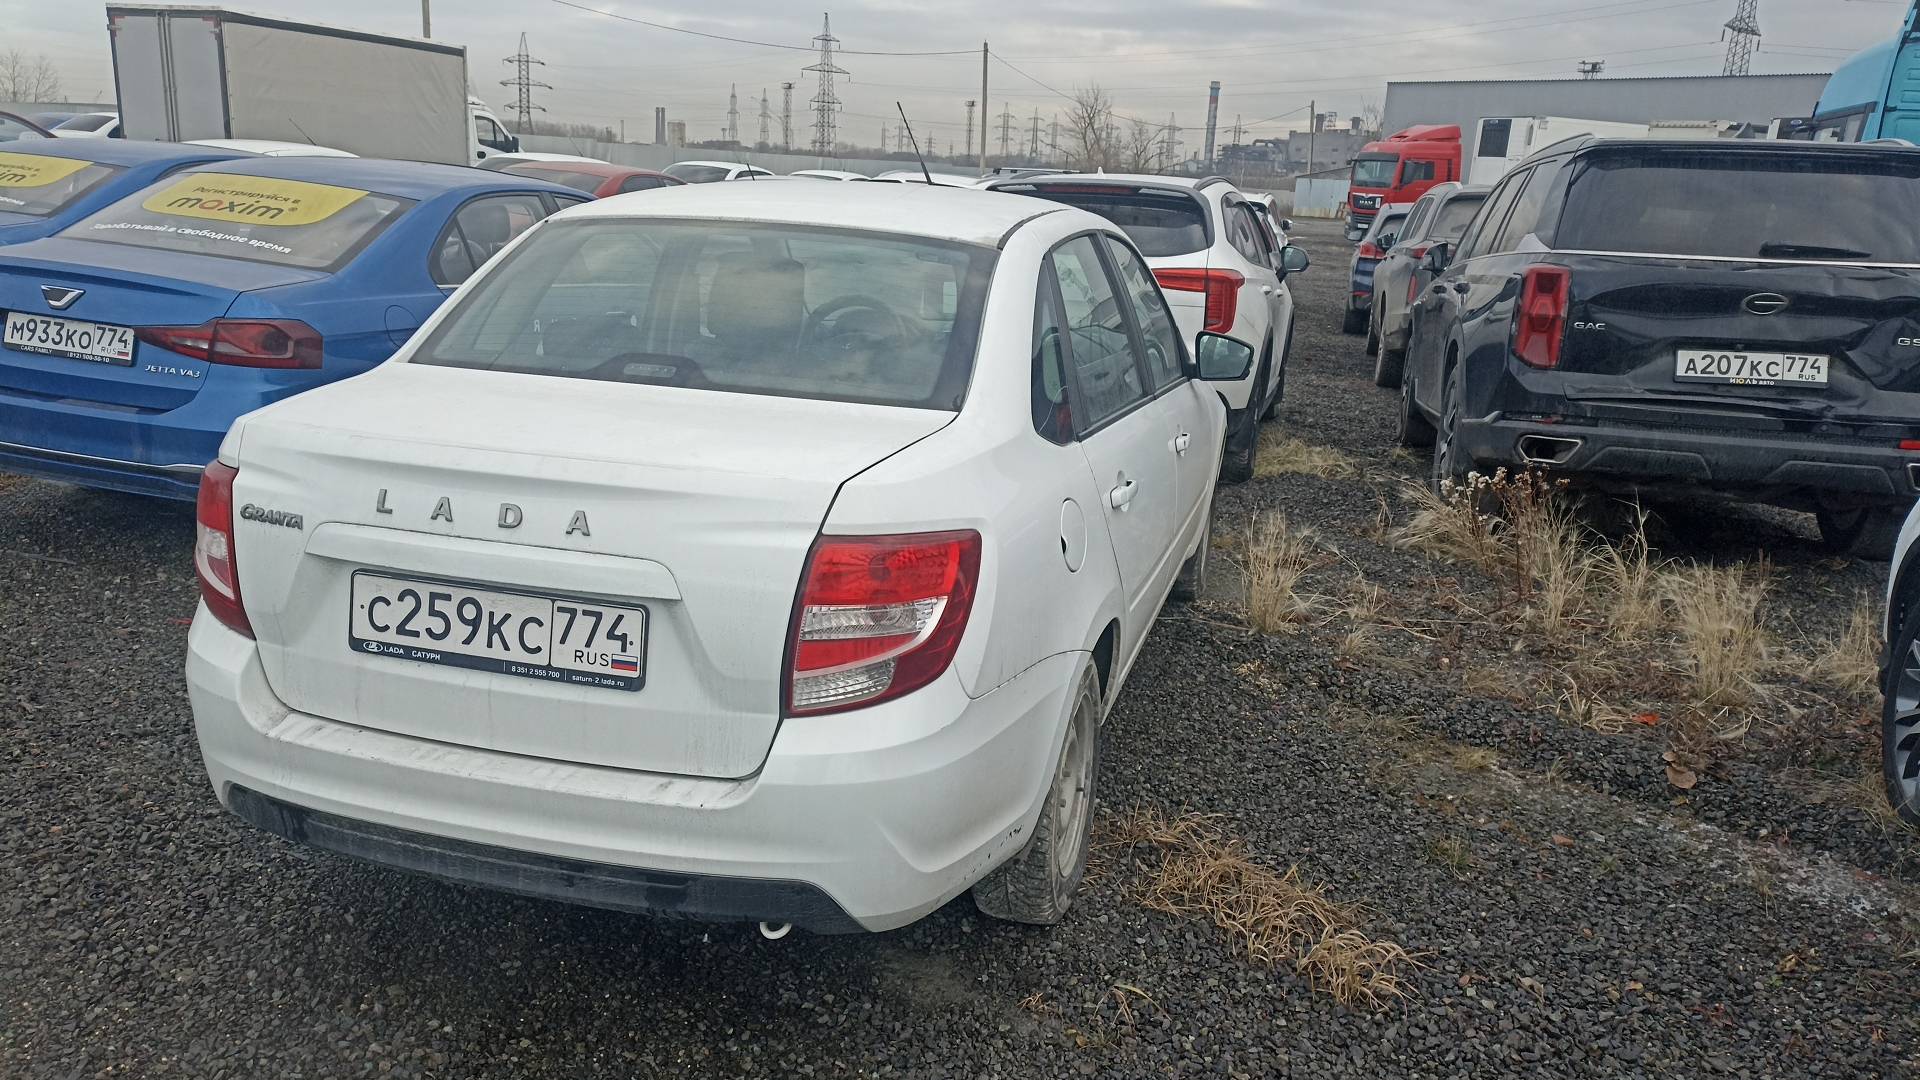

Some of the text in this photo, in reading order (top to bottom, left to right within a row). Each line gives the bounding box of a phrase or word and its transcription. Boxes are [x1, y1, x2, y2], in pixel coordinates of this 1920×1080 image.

[166, 197, 285, 219] maxim
[177, 228, 248, 243] свободное
[248, 239, 292, 254] время
[1573, 321, 1606, 330] GAC
[96, 326, 129, 349] 774
[101, 347, 117, 355] RUS
[145, 364, 201, 378] JETTA VA3
[1785, 356, 1821, 374] 774
[1729, 377, 1758, 385] ИЮЛЬ
[375, 488, 591, 537] LADA
[556, 606, 628, 653] 774
[384, 645, 405, 655] LADA
[411, 650, 441, 661] САТУРН
[574, 649, 609, 667] RUS
[511, 665, 516, 673] 8
[529, 667, 534, 675] 2
[548, 670, 560, 678] 700
